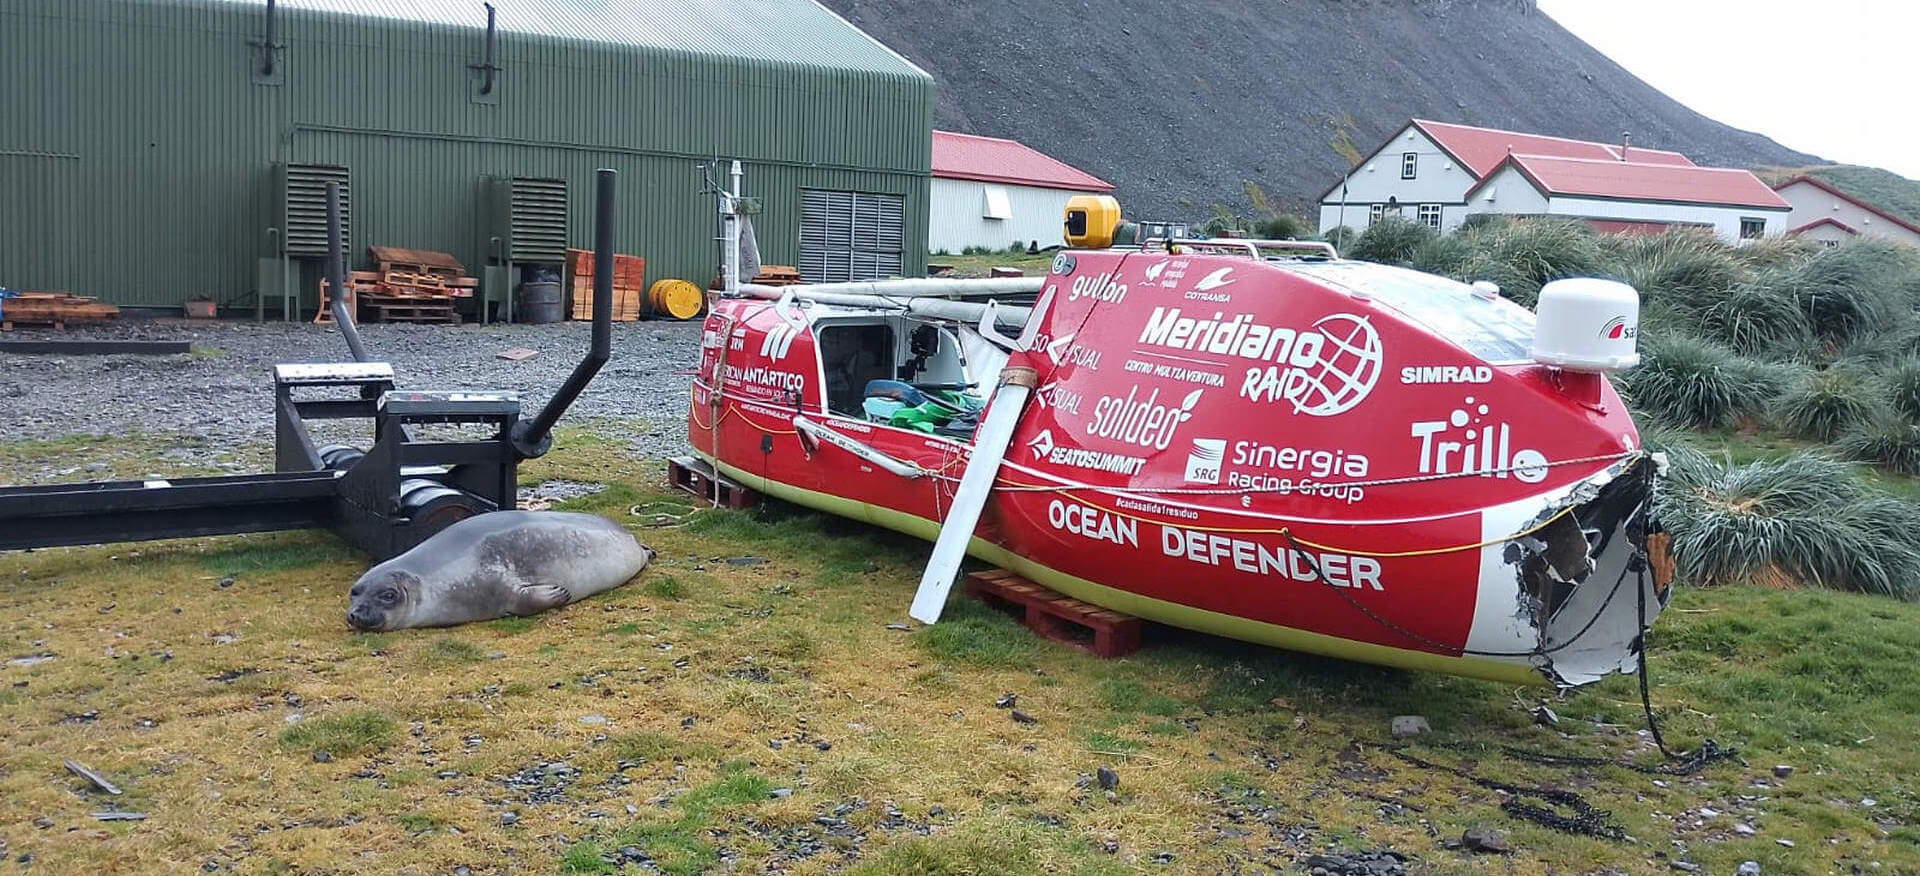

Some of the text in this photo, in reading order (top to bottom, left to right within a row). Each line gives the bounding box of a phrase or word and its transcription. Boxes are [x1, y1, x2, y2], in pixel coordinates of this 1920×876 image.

[1069, 272, 1128, 304] gullón
[1184, 291, 1231, 303] COTRANSA
[1138, 307, 1326, 368] Meridiano
[743, 366, 804, 394] ANTÁRTICO
[1124, 360, 1225, 388] CENTRO MULTIAVENTURA
[1240, 366, 1311, 414] RAID
[1401, 366, 1494, 385] SIMRAD
[1087, 383, 1182, 450] solideo
[1193, 467, 1217, 481] SRG
[1232, 441, 1369, 478] Sinergia
[1229, 471, 1364, 505] Racing Group
[1049, 500, 1384, 591] OCEAN DEFENDER
